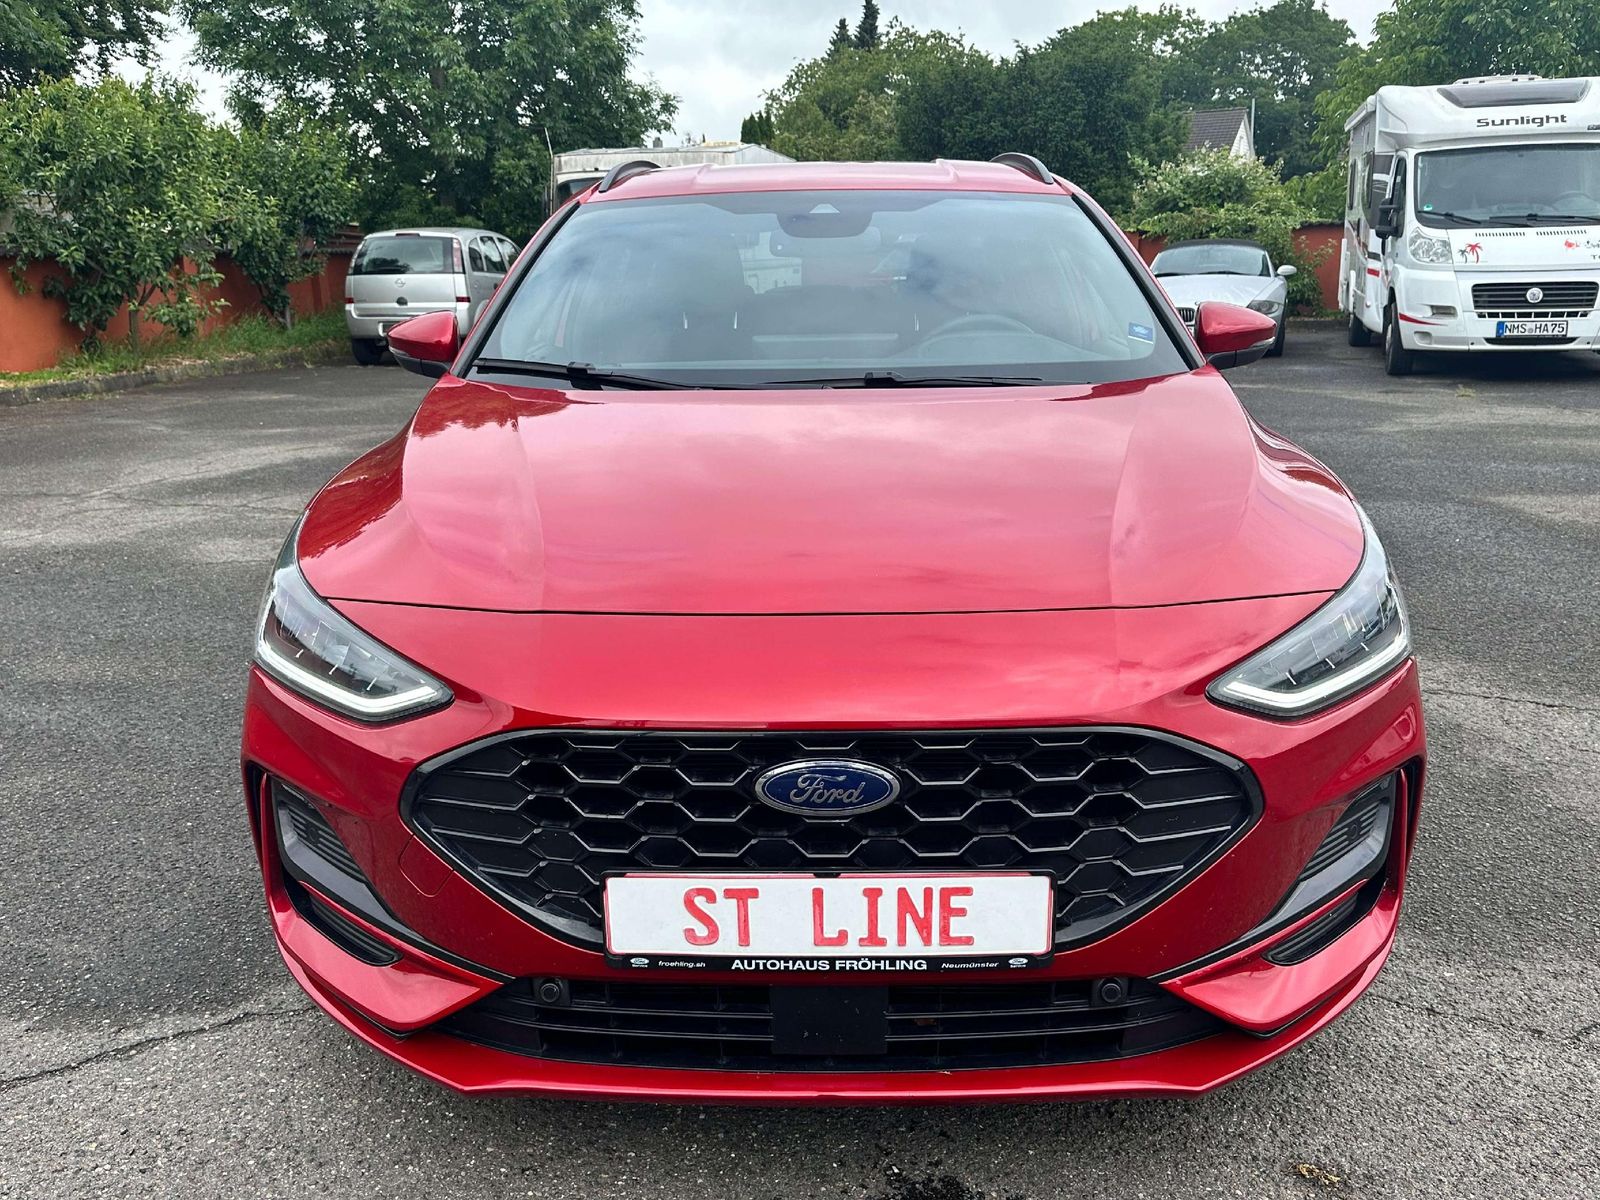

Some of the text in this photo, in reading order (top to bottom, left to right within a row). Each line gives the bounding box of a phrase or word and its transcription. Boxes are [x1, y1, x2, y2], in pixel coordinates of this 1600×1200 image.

[1476, 114, 1567, 128] Sunlight
[1504, 323, 1527, 334] NMS
[789, 773, 866, 804] Ford
[683, 886, 975, 946] ST LINE
[658, 960, 706, 968] froehling.sh
[731, 957, 928, 971] AUTOHAUS FRÖHLING
